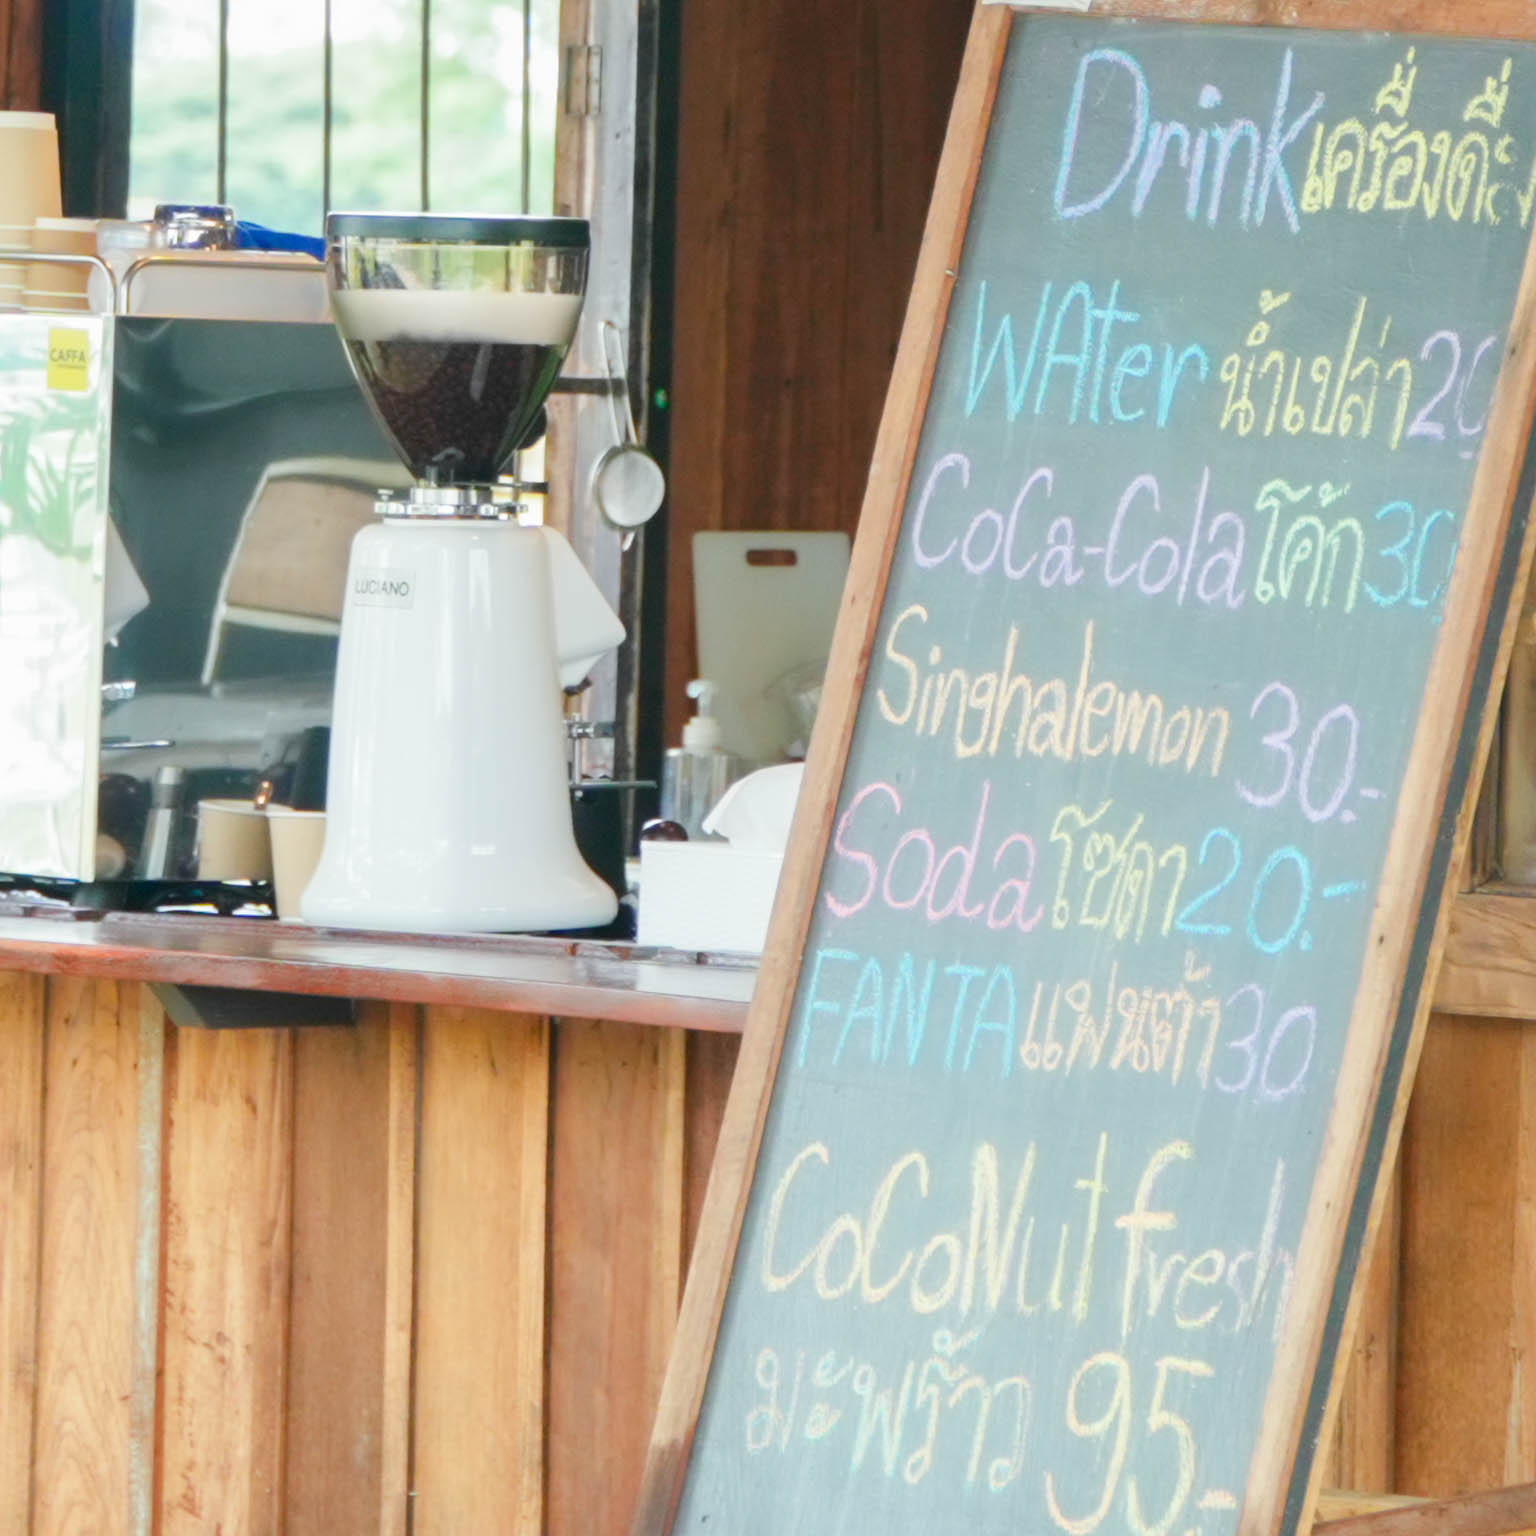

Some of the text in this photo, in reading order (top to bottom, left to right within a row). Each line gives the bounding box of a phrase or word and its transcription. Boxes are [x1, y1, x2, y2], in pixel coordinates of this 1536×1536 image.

[1053, 47, 1327, 235] Drink
[354, 577, 410, 597] LUCIANO
[824, 779, 1045, 932] Soda
[796, 948, 1018, 1080] FANTA
